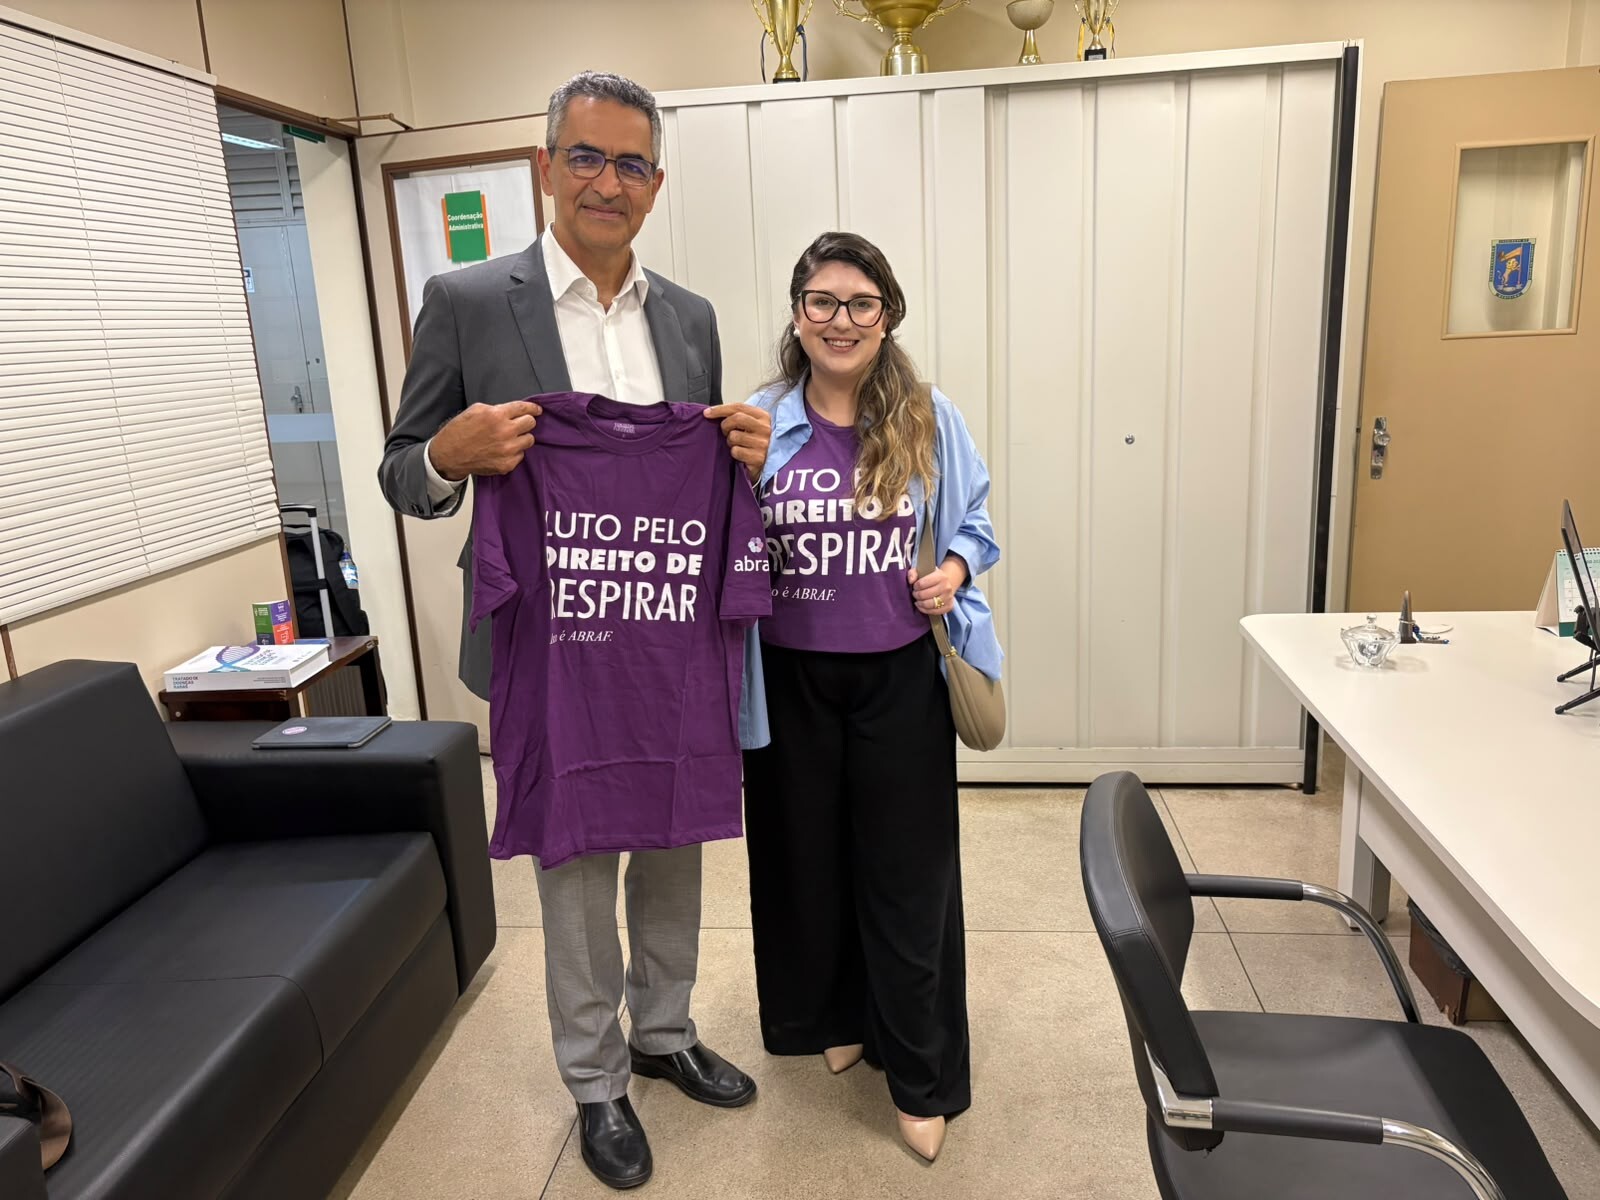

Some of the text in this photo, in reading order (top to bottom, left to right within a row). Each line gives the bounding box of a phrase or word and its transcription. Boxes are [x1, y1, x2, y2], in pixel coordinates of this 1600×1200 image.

[447, 212, 483, 222] Coordenação
[448, 222, 484, 231] Administrativa
[760, 493, 915, 529] DIREITO D
[633, 516, 706, 546] PELO
[545, 545, 703, 576] DIREITO DE
[733, 555, 770, 572] abra
[782, 586, 790, 598] é
[791, 587, 836, 602] ABRAF.
[559, 629, 566, 642] é
[568, 630, 614, 642] ABRAF.
